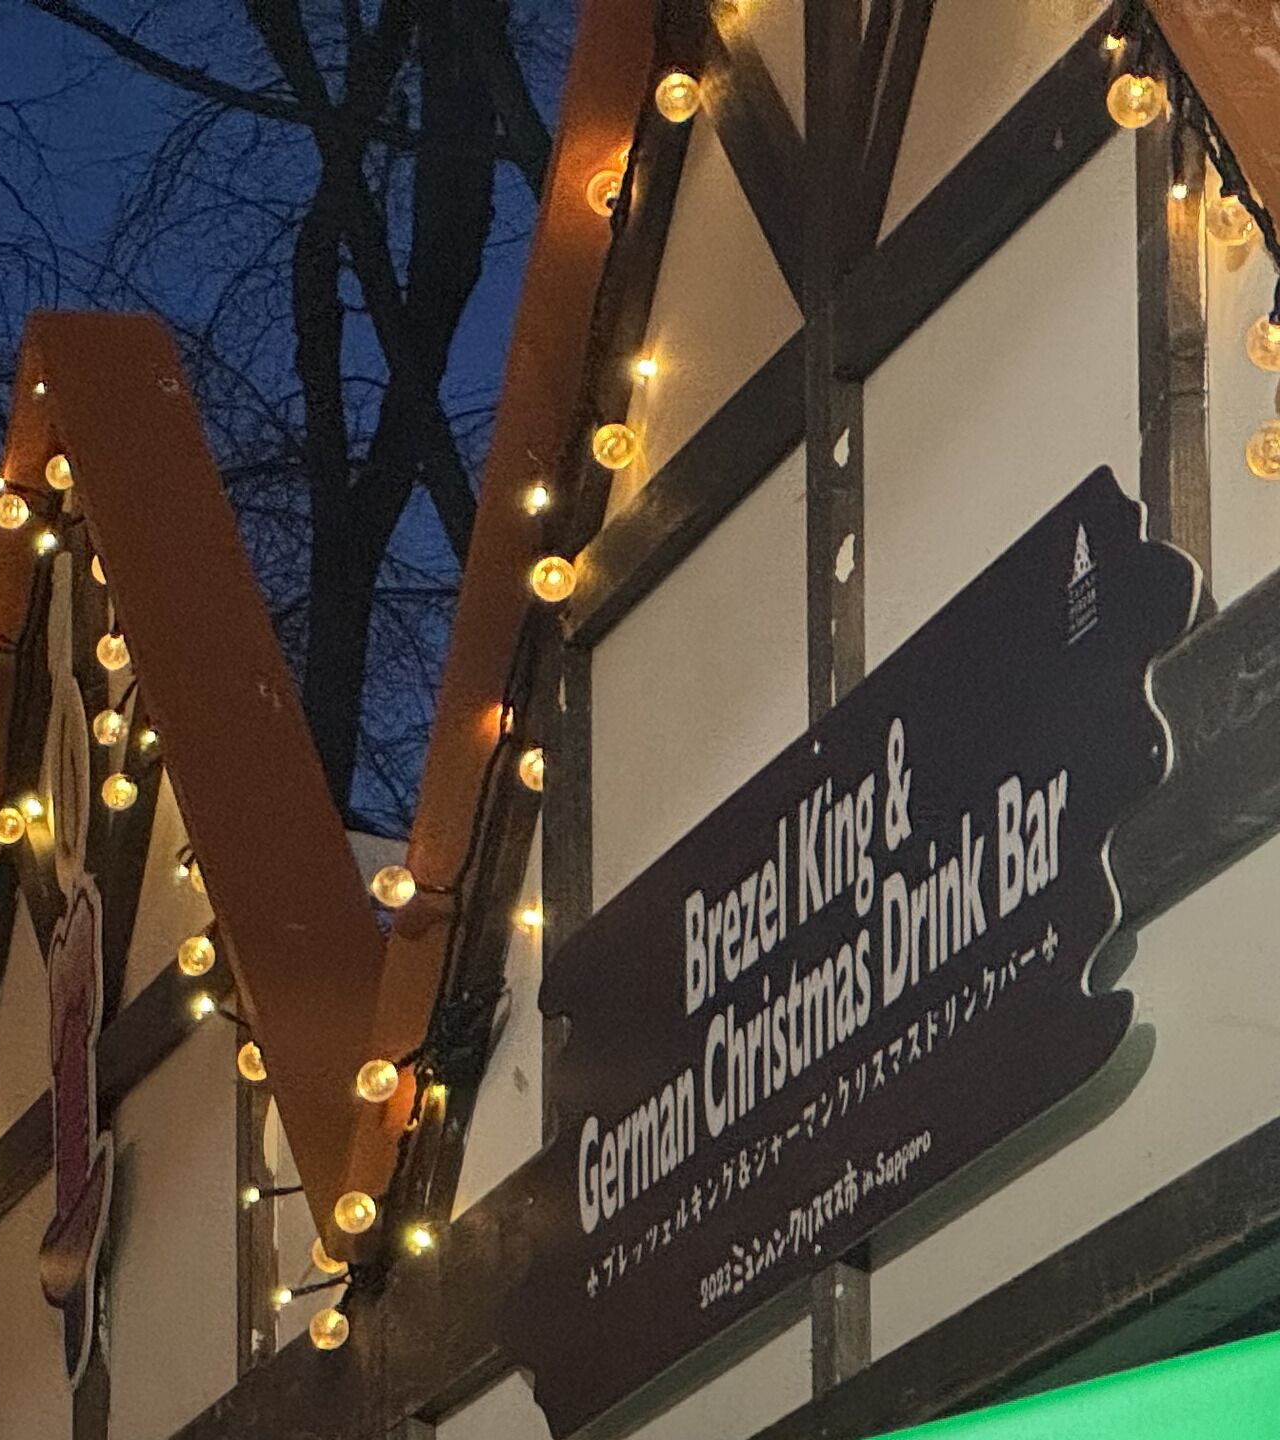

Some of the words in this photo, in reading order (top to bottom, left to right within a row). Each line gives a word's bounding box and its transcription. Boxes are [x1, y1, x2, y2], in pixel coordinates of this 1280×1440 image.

[578, 1066, 696, 1235] German
[704, 927, 872, 1139] Christmas
[882, 810, 988, 1008] Drink
[997, 767, 1068, 918] Bar
[685, 815, 787, 1016] Brezel
[798, 771, 875, 926] King
[885, 716, 913, 852] &
[876, 1130, 933, 1187] Sapporo
